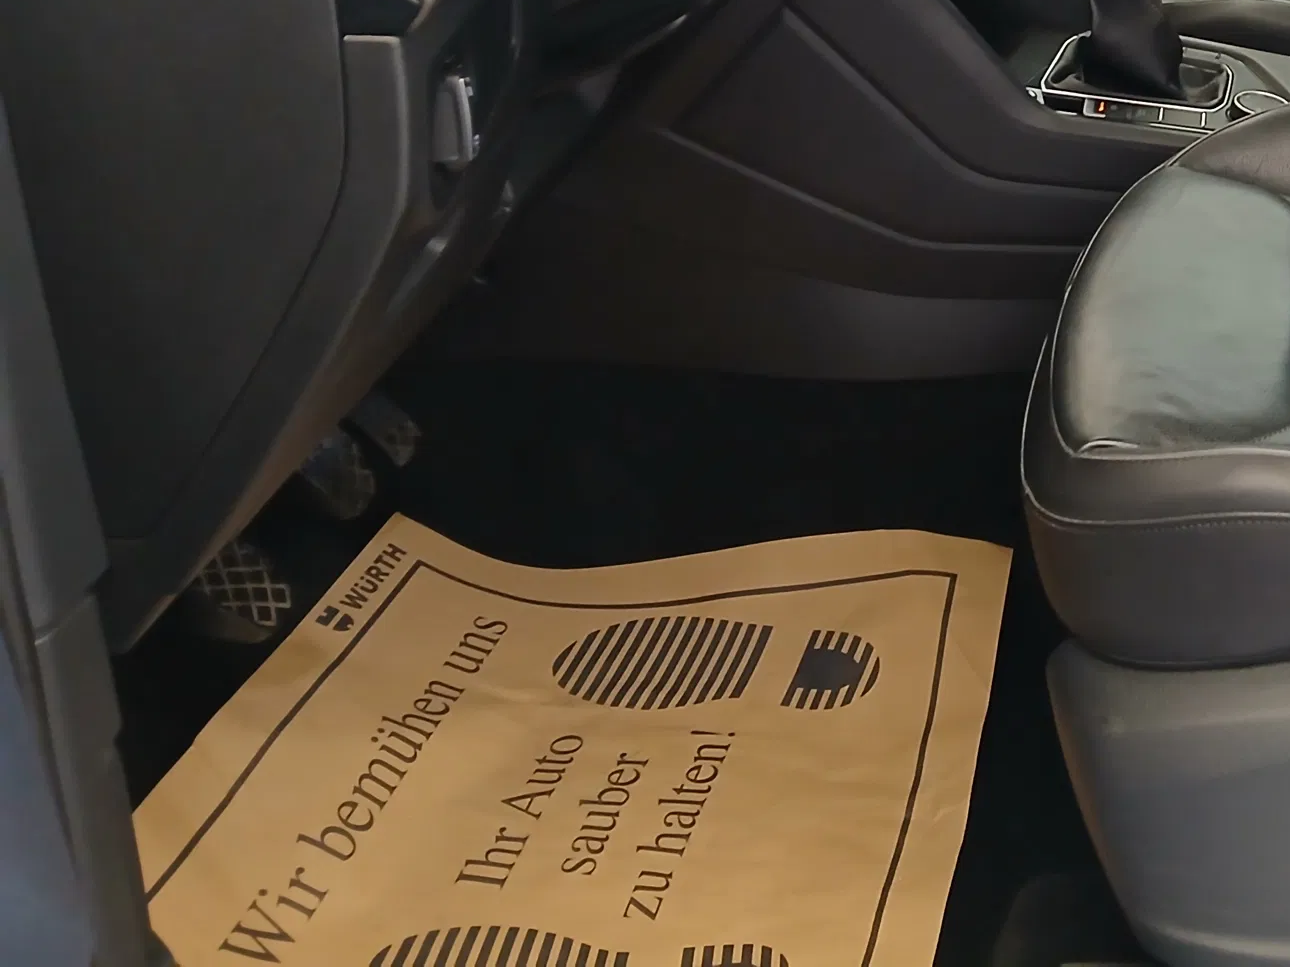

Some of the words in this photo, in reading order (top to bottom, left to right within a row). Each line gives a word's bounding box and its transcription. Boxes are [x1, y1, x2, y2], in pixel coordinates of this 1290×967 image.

[339, 543, 407, 610] WÜRTH
[218, 866, 329, 964] Wir
[295, 680, 466, 862] bemühen
[442, 615, 508, 674] uns
[455, 826, 530, 890] Ihr
[500, 734, 584, 821] Auto
[560, 752, 650, 876] sauber
[636, 729, 736, 858] halten!
[622, 870, 674, 921] zu
